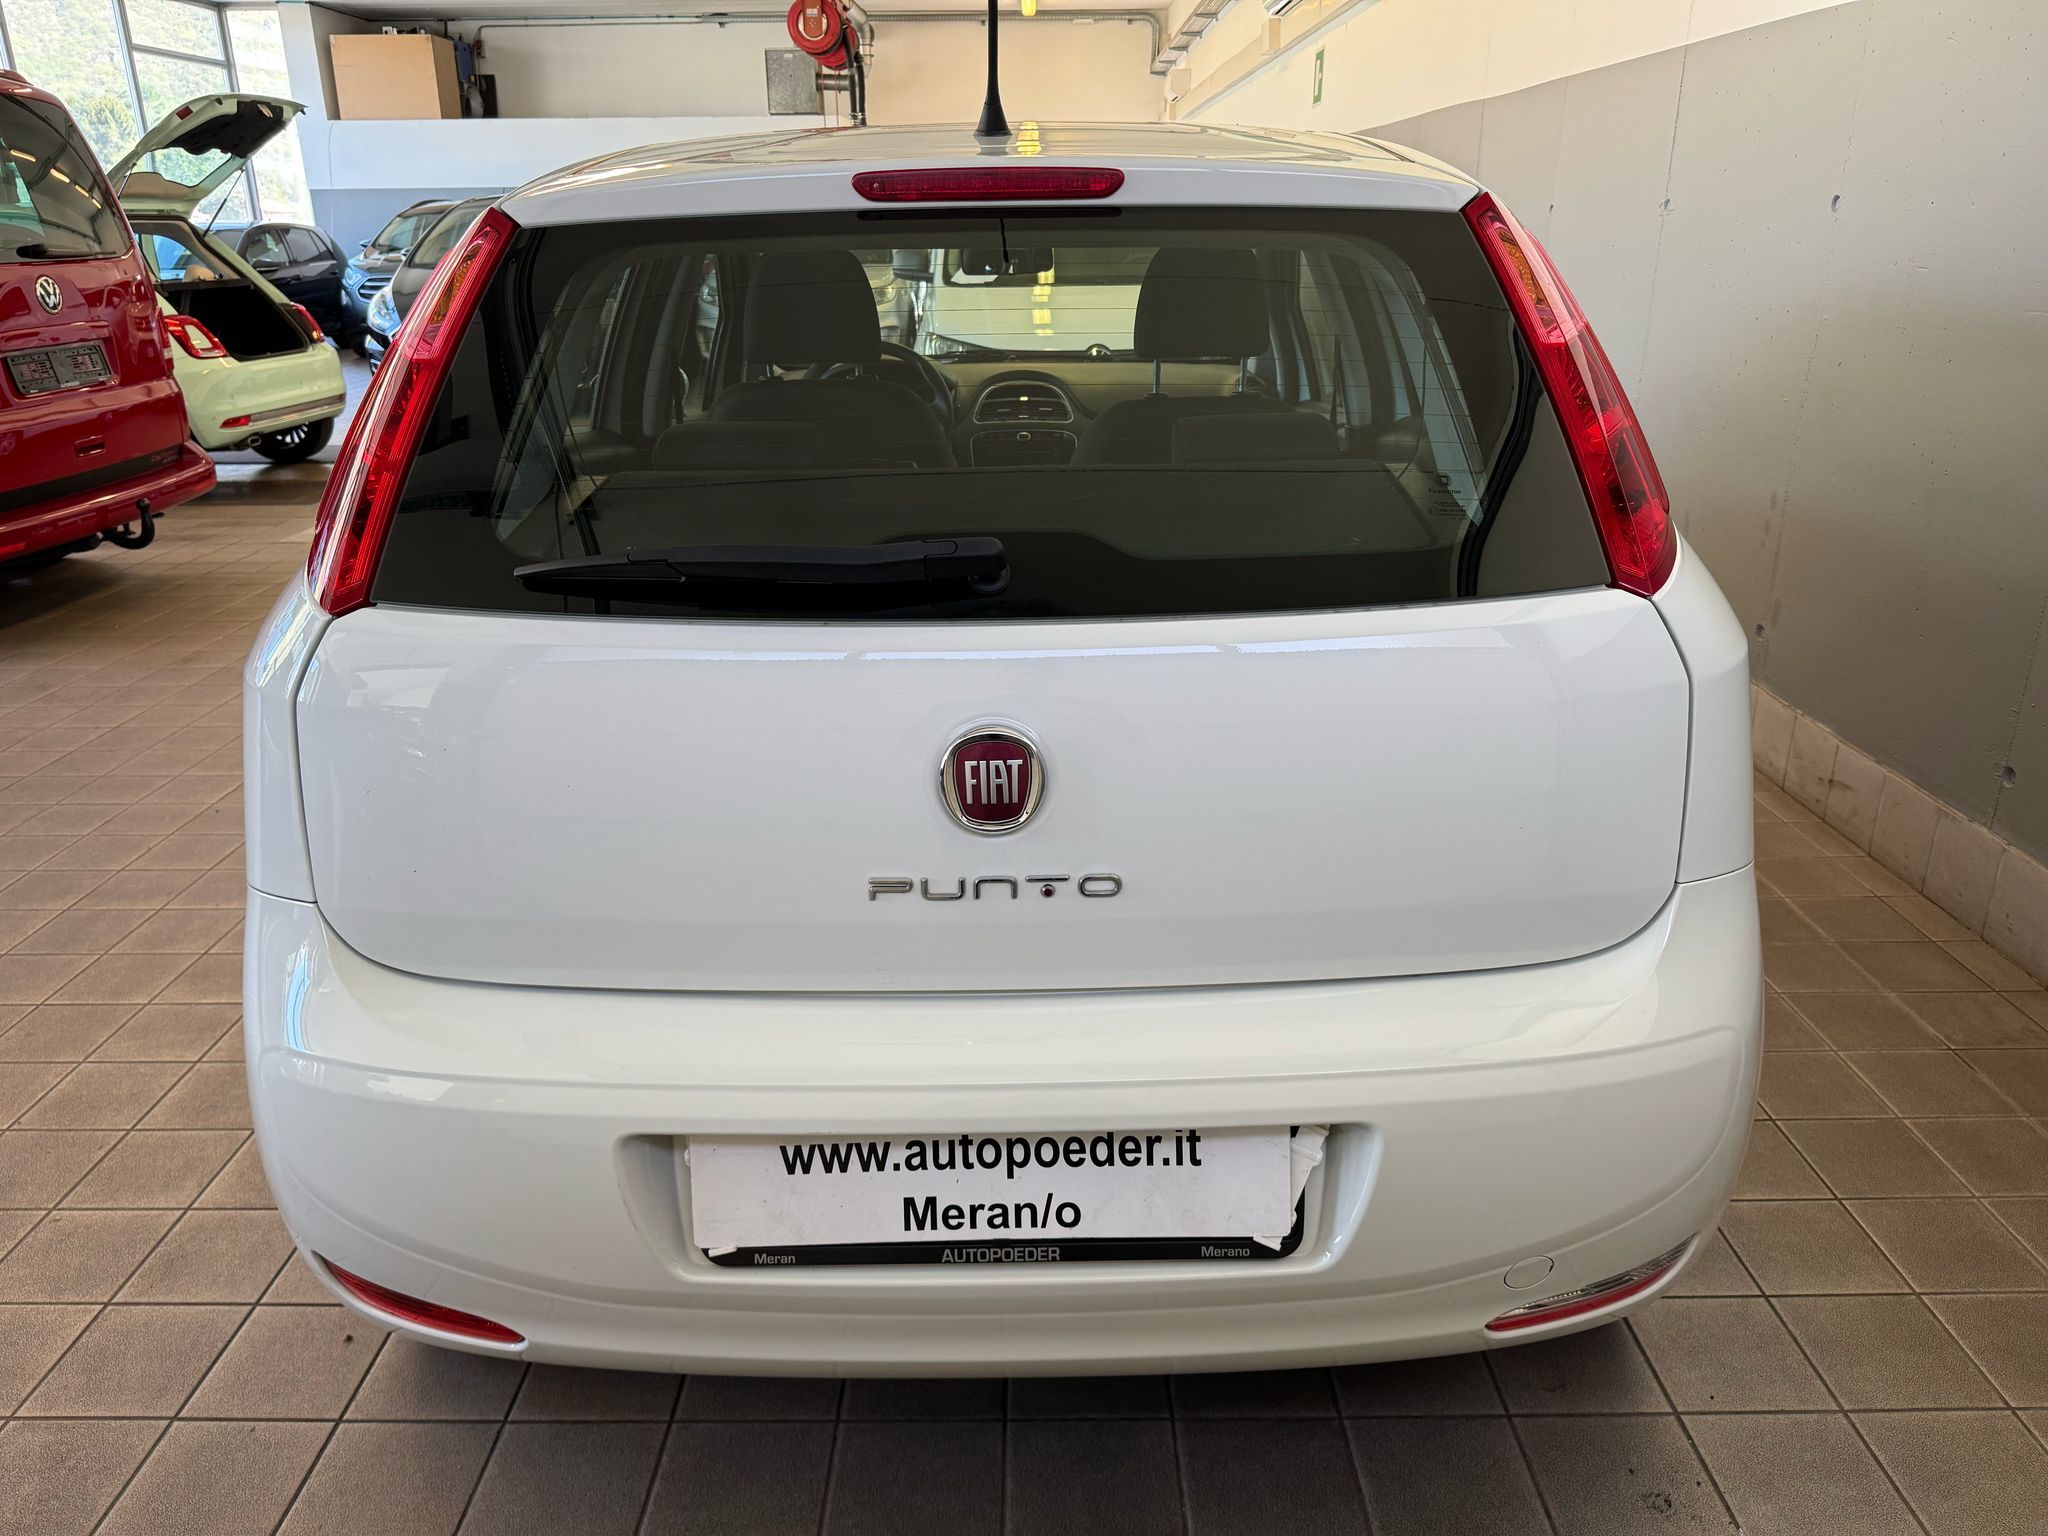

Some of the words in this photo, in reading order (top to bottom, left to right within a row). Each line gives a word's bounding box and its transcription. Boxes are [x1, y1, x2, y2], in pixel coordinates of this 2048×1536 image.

[964, 759, 1023, 805] FIAT
[868, 873, 1123, 901] PUNTO
[779, 1129, 1202, 1180] www.autopoeder.it
[903, 1193, 1082, 1232] Meran/o
[753, 1252, 797, 1265] Meran
[941, 1246, 1061, 1264] AUTOPOEDER
[1201, 1245, 1251, 1258] Merano
